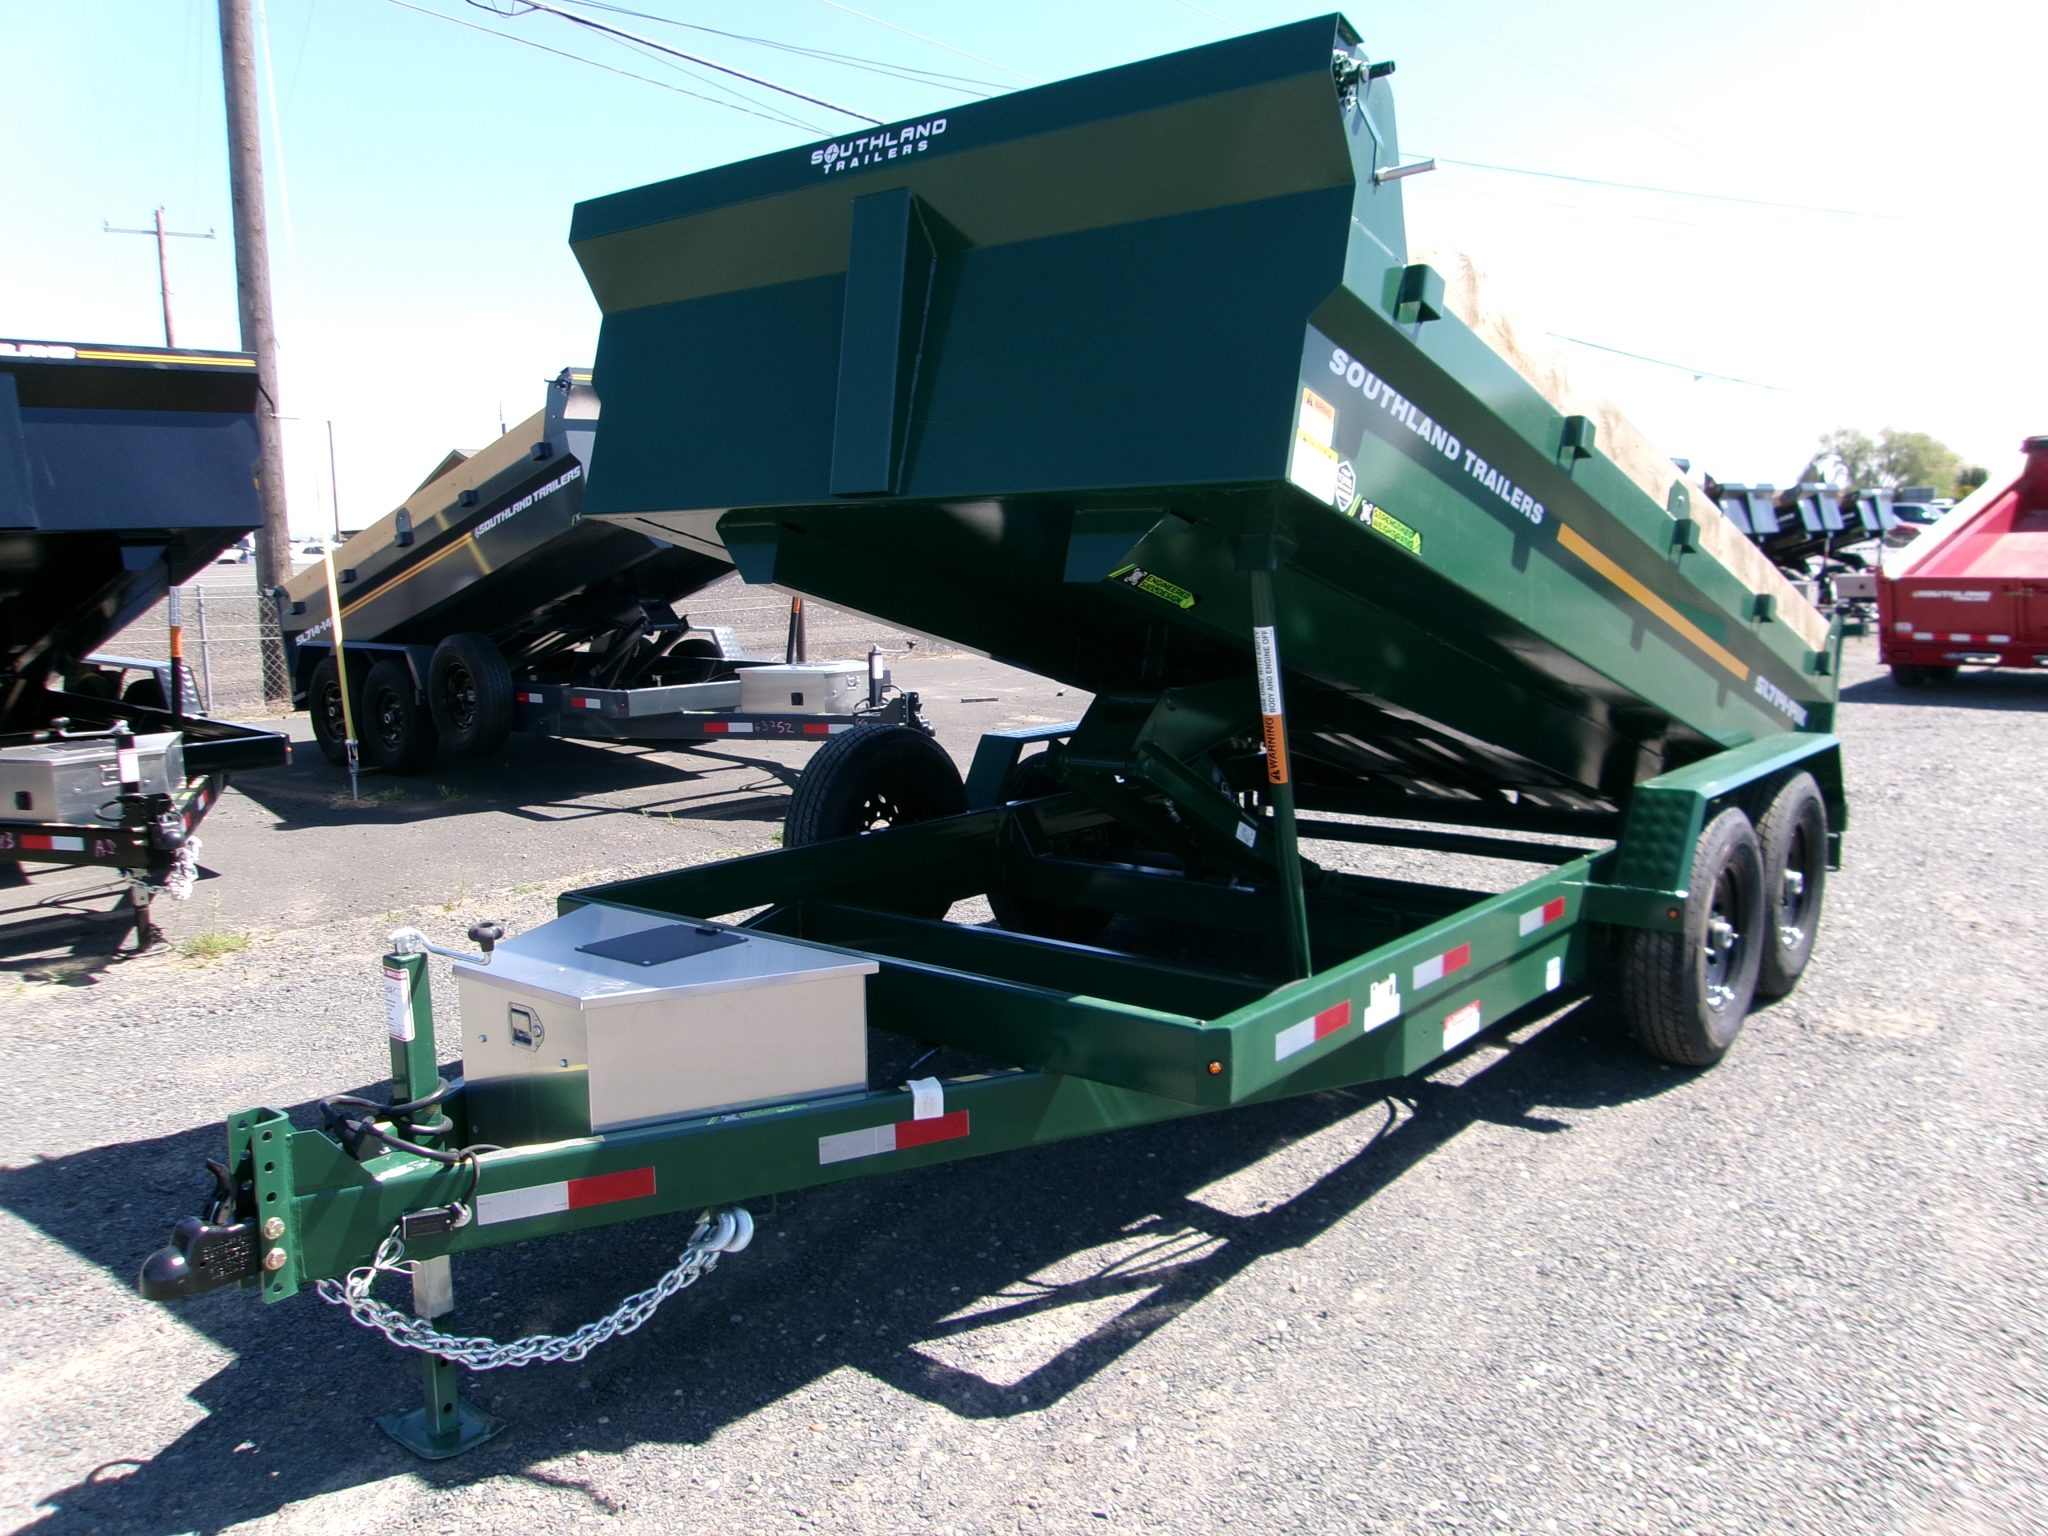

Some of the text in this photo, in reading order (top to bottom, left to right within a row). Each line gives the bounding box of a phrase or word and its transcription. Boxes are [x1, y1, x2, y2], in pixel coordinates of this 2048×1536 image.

[810, 118, 947, 165] SOUTHLAND
[823, 140, 929, 175] TRAILERS
[1329, 348, 1461, 461] SOUTHLAND
[1463, 449, 1544, 525] TRAILERS
[478, 465, 581, 536] SOUTHLAND TRAILERS
[1263, 646, 1272, 674] ENGINE
[1265, 676, 1274, 691] AND
[1267, 693, 1276, 713] BODY
[1265, 717, 1278, 769] WARNING
